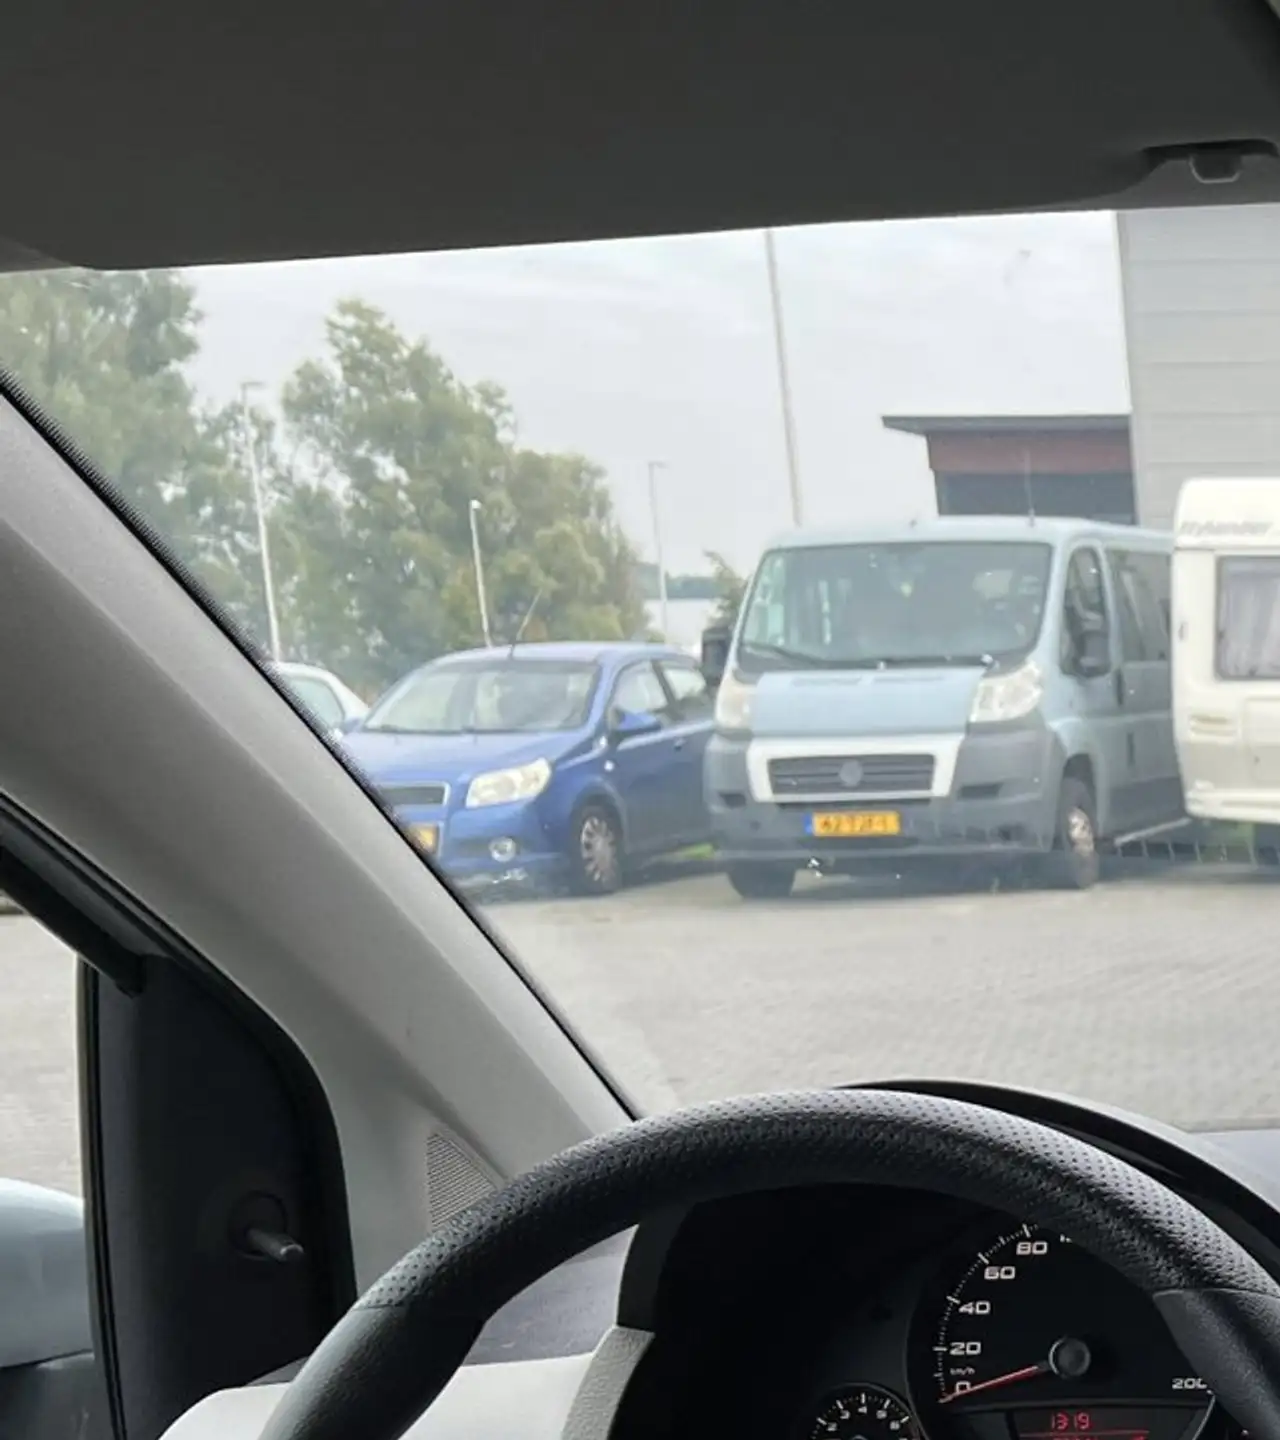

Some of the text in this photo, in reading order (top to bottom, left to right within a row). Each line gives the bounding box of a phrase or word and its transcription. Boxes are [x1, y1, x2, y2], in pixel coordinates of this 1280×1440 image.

[1016, 1240, 1049, 1256] 80
[984, 1266, 1016, 1281] 60
[958, 1300, 991, 1316] 40
[949, 1341, 982, 1356] 20
